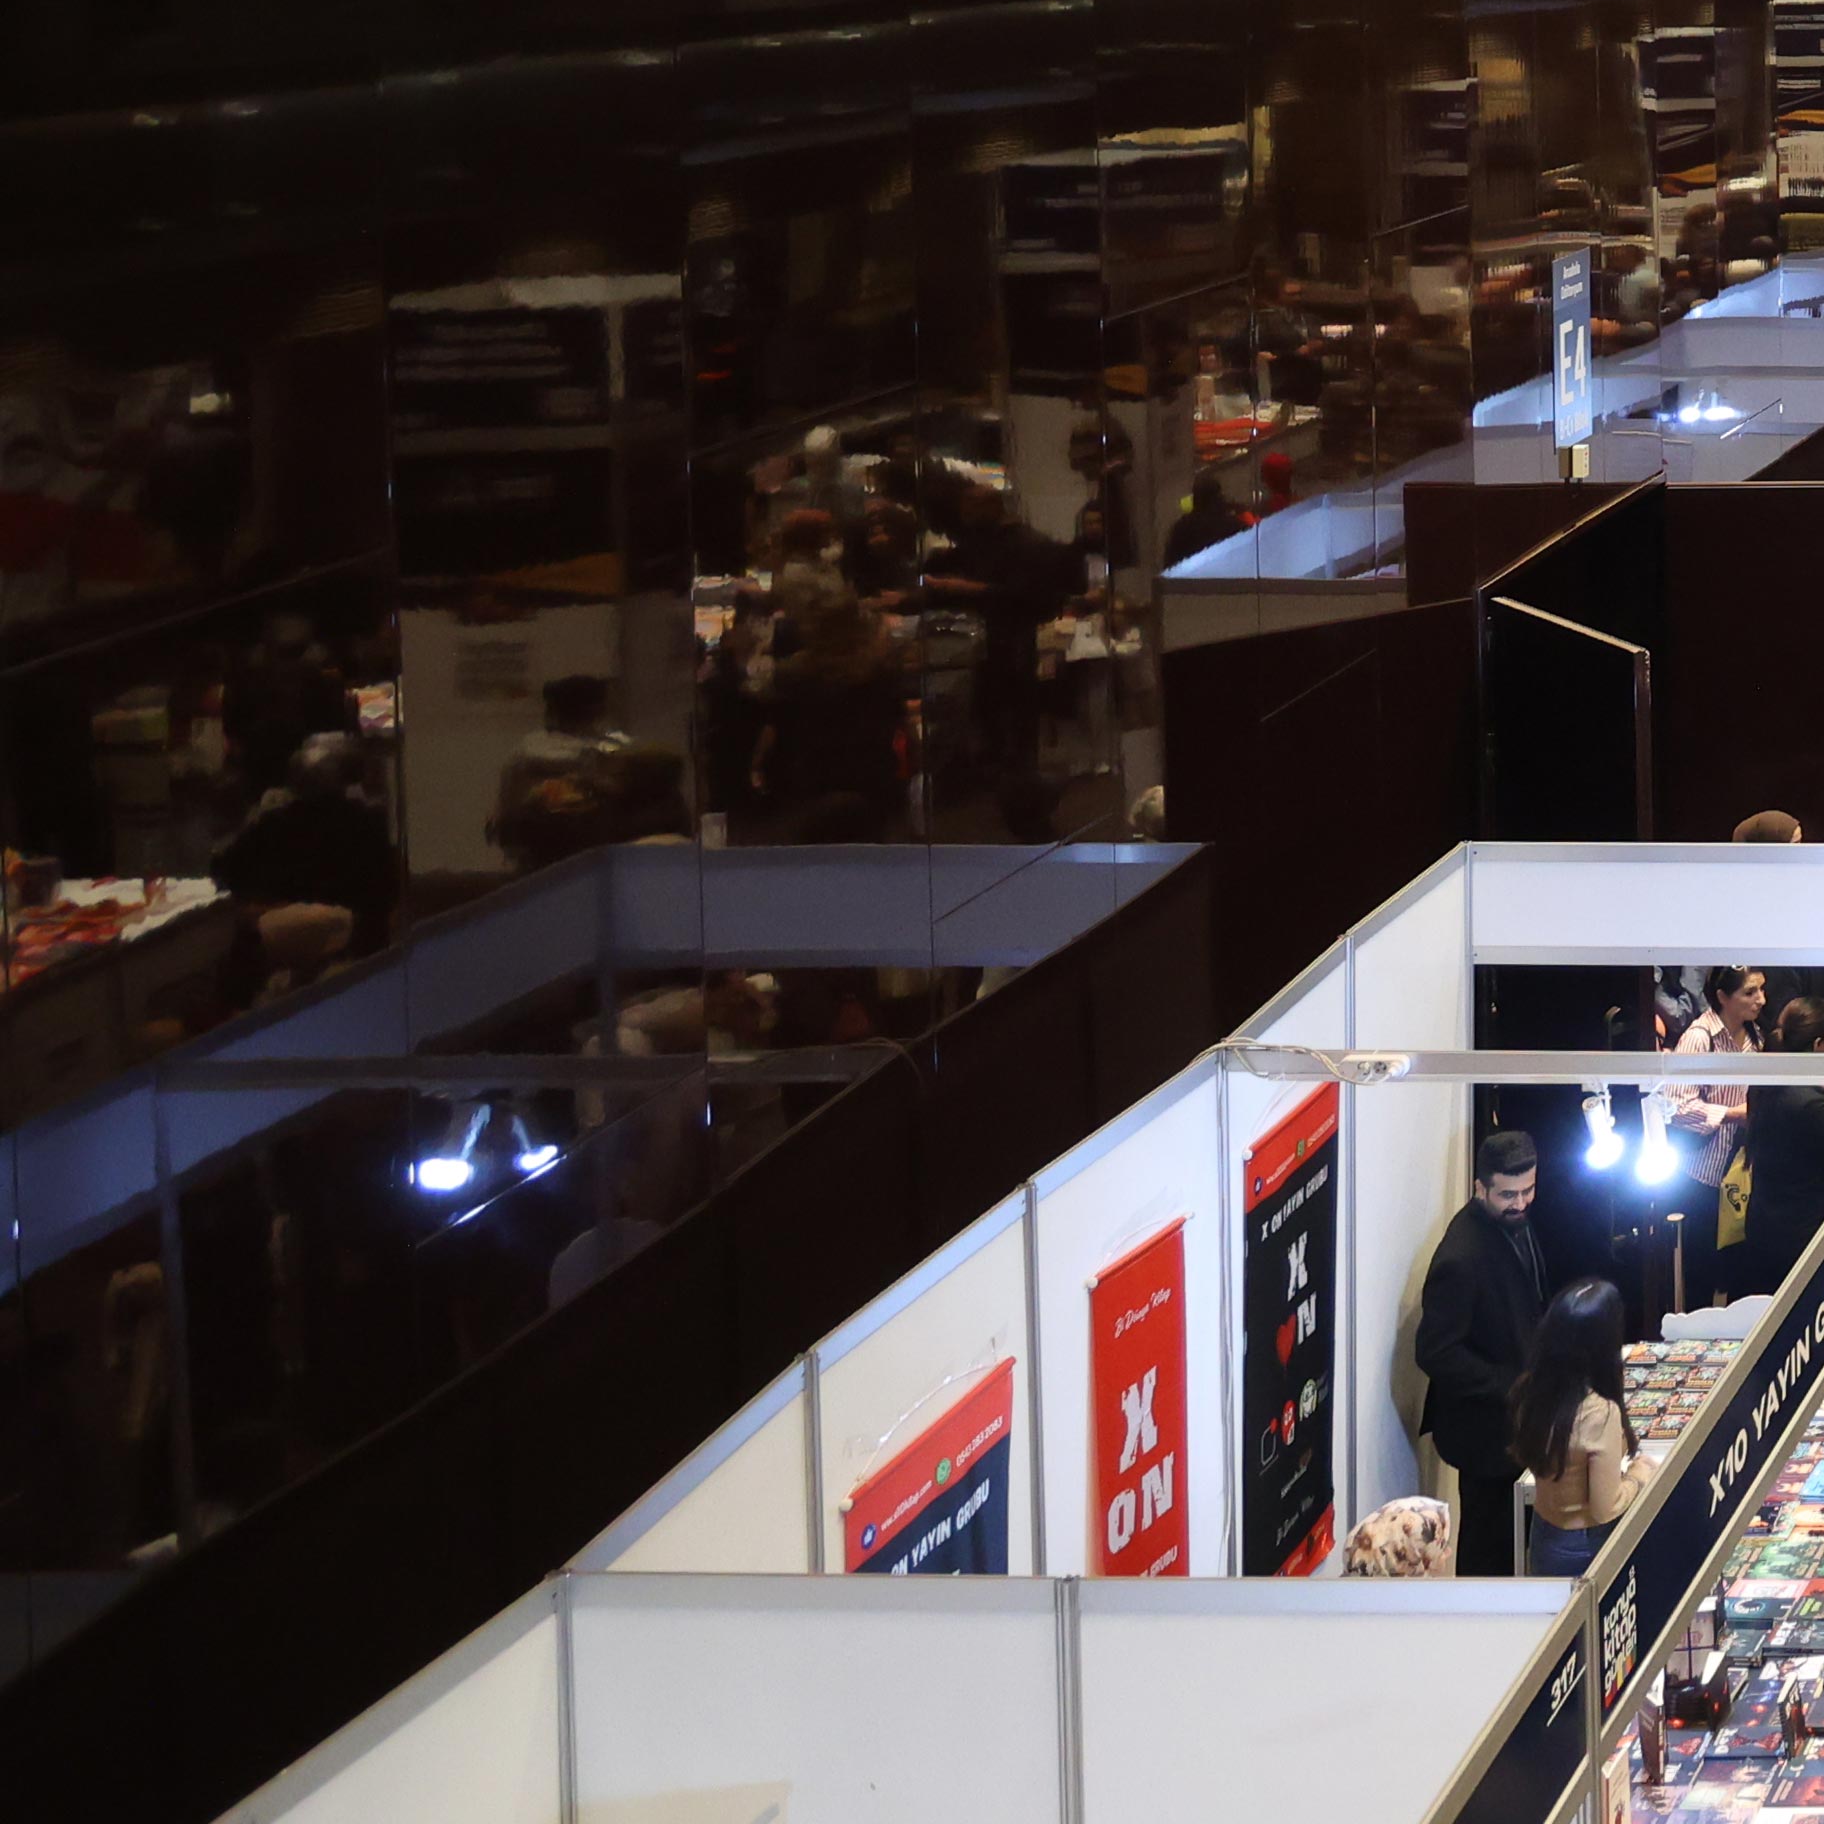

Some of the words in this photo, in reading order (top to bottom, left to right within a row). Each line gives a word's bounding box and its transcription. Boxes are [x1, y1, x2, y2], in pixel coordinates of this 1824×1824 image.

[1560, 320, 1587, 406] E4
[1283, 1187, 1304, 1221] YAYIN
[1306, 1164, 1328, 1199] GRUBU
[1119, 1365, 1157, 1474] X
[1709, 1427, 1748, 1518] X10
[1752, 1325, 1811, 1441] YAYIN
[912, 1516, 951, 1567] YAYIN
[956, 1478, 990, 1531] GRUBU
[1107, 1451, 1174, 1554] ON
[1604, 1577, 1636, 1639] konya
[1604, 1603, 1637, 1670] kitap
[1551, 1651, 1577, 1710] 317
